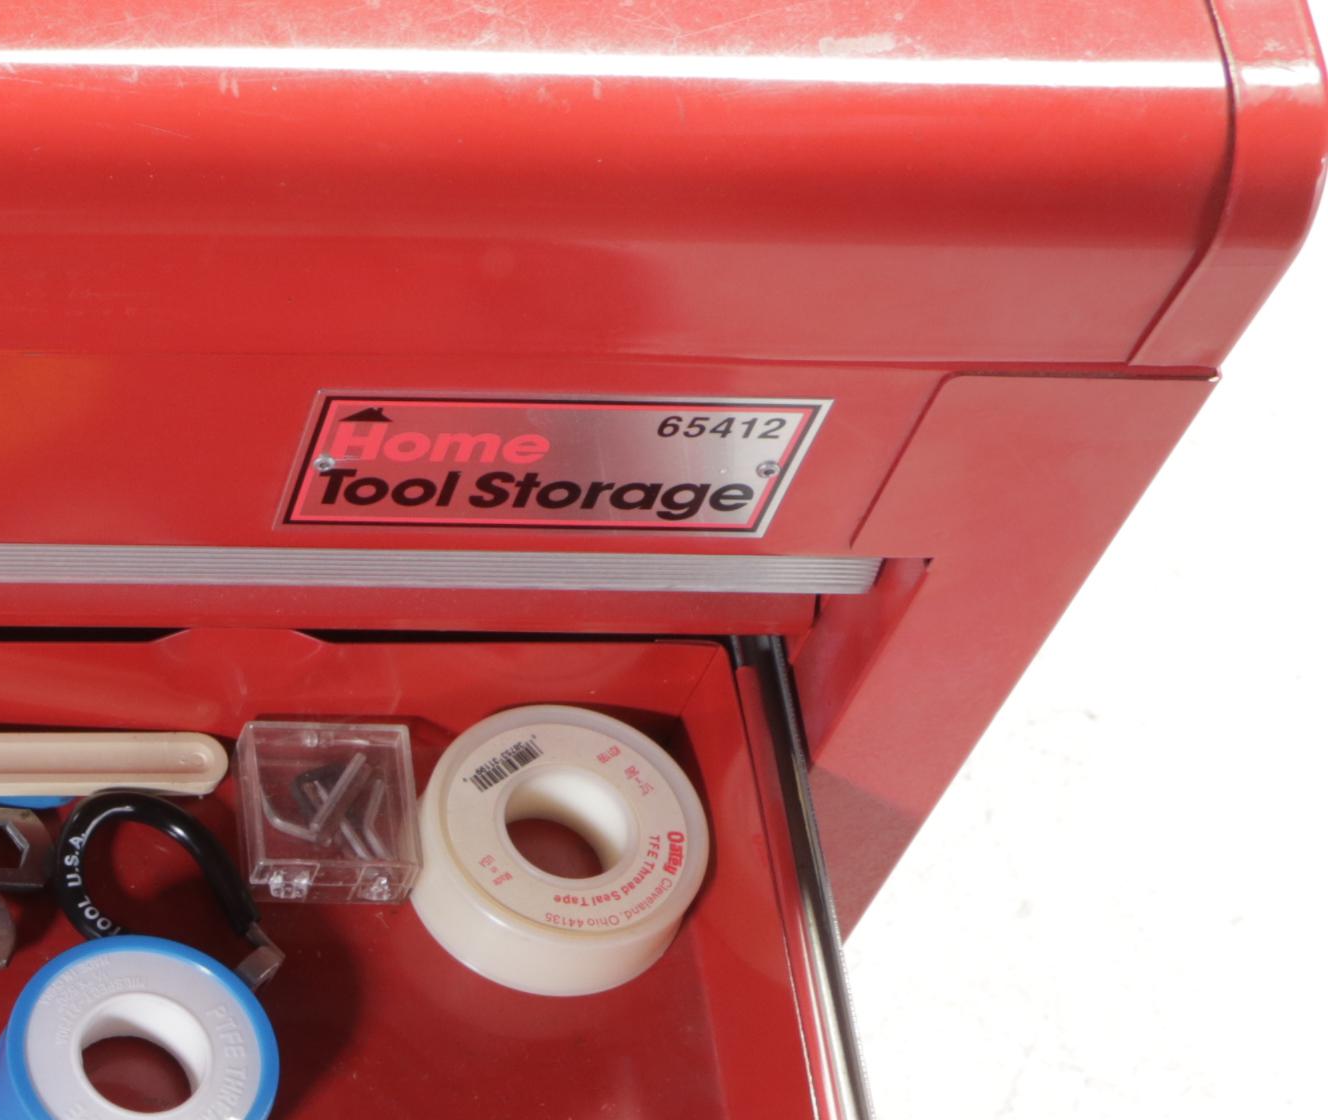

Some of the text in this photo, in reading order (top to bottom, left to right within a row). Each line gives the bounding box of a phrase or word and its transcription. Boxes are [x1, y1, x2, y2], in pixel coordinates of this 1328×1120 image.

[337, 422, 550, 465] Home
[657, 416, 787, 439] 65412
[318, 468, 754, 521] Tool Storage
[553, 834, 661, 907] TFE Thread Seal Tape
[545, 912, 584, 928] 44135
[587, 914, 620, 927] Ohio
[205, 1005, 245, 1058] PTFE
